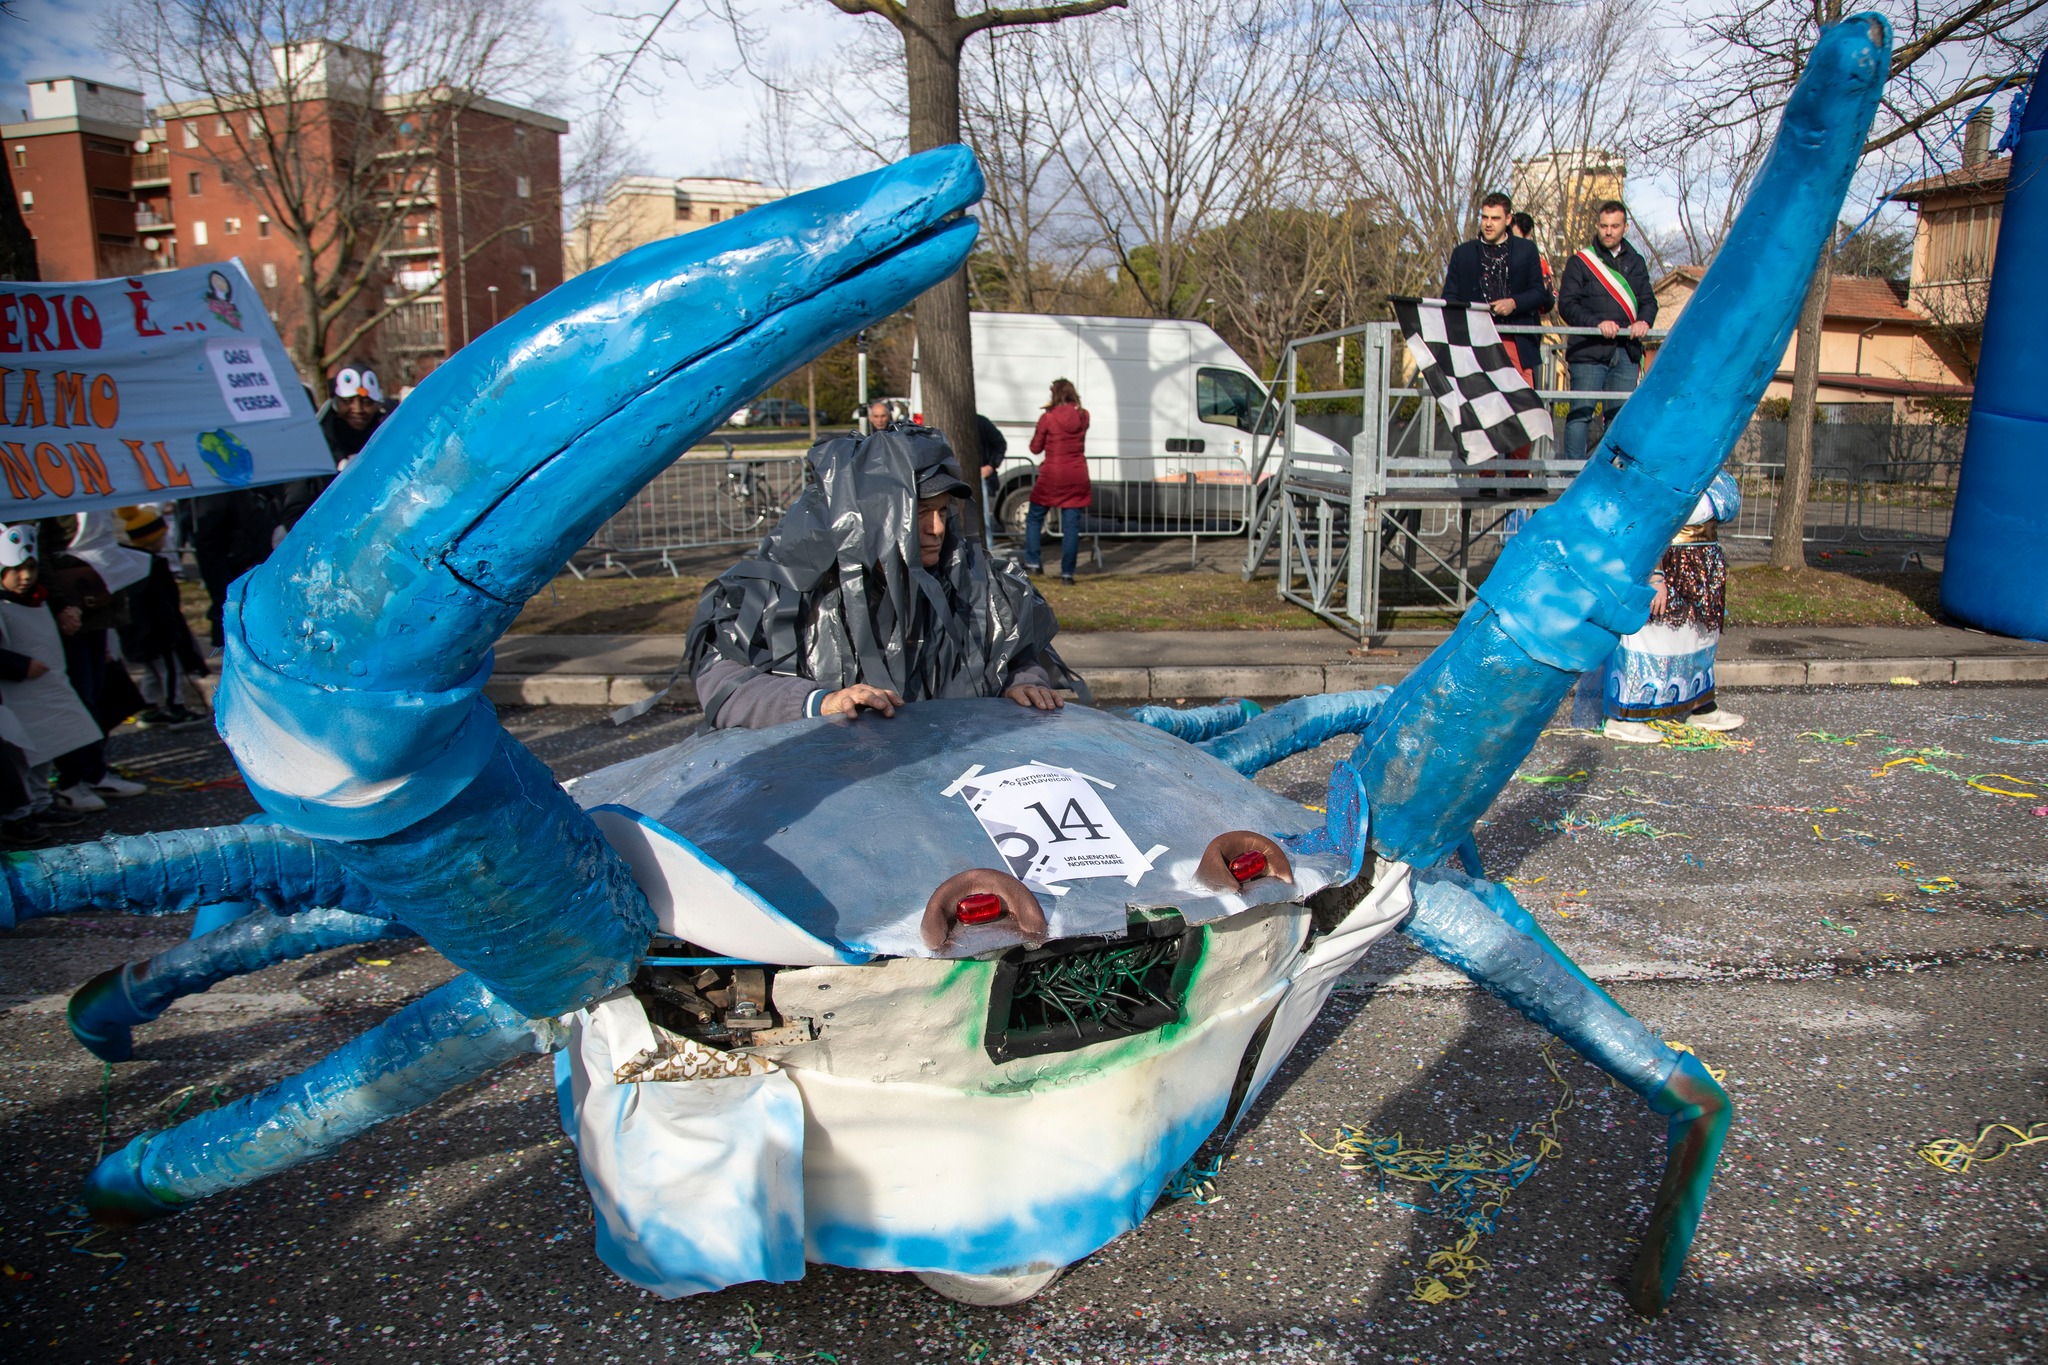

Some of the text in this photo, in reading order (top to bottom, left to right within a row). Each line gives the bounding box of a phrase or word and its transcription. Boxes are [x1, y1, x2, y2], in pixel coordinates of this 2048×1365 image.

[227, 372, 270, 388] SANTA
[233, 394, 282, 412] TERESA
[0, 438, 193, 500] NON IL
[1015, 772, 1060, 783] carnevale
[1018, 776, 1072, 787] fantaveicoli
[1024, 798, 1110, 843] 14
[1067, 859, 1102, 867] NOSTRO
